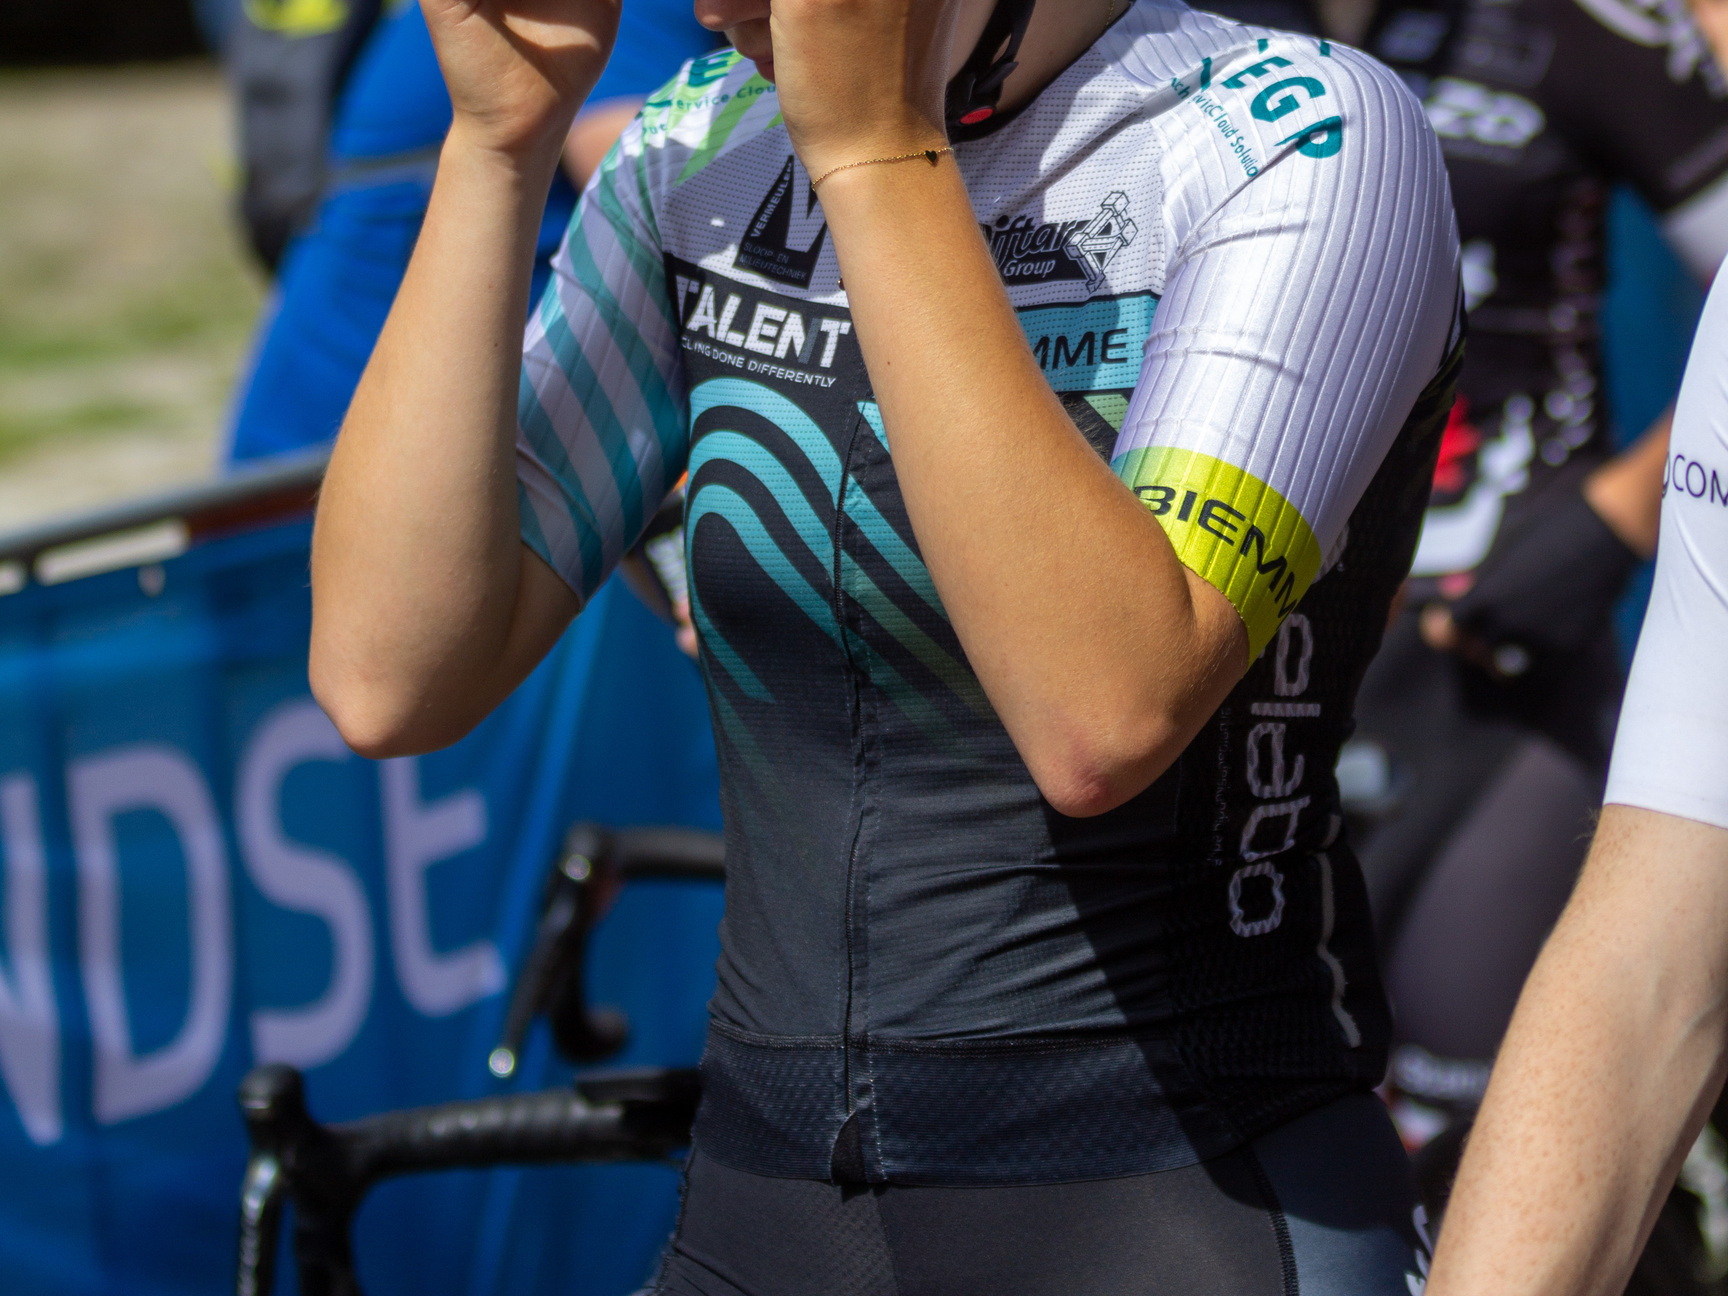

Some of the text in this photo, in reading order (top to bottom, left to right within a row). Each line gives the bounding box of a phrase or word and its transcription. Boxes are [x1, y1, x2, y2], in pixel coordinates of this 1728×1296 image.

[1003, 259, 1056, 279] Group
[675, 274, 852, 369] TALENT
[711, 348, 745, 369] DONE
[747, 359, 837, 389] DIFFERENTLY
[1661, 451, 1728, 509] COM
